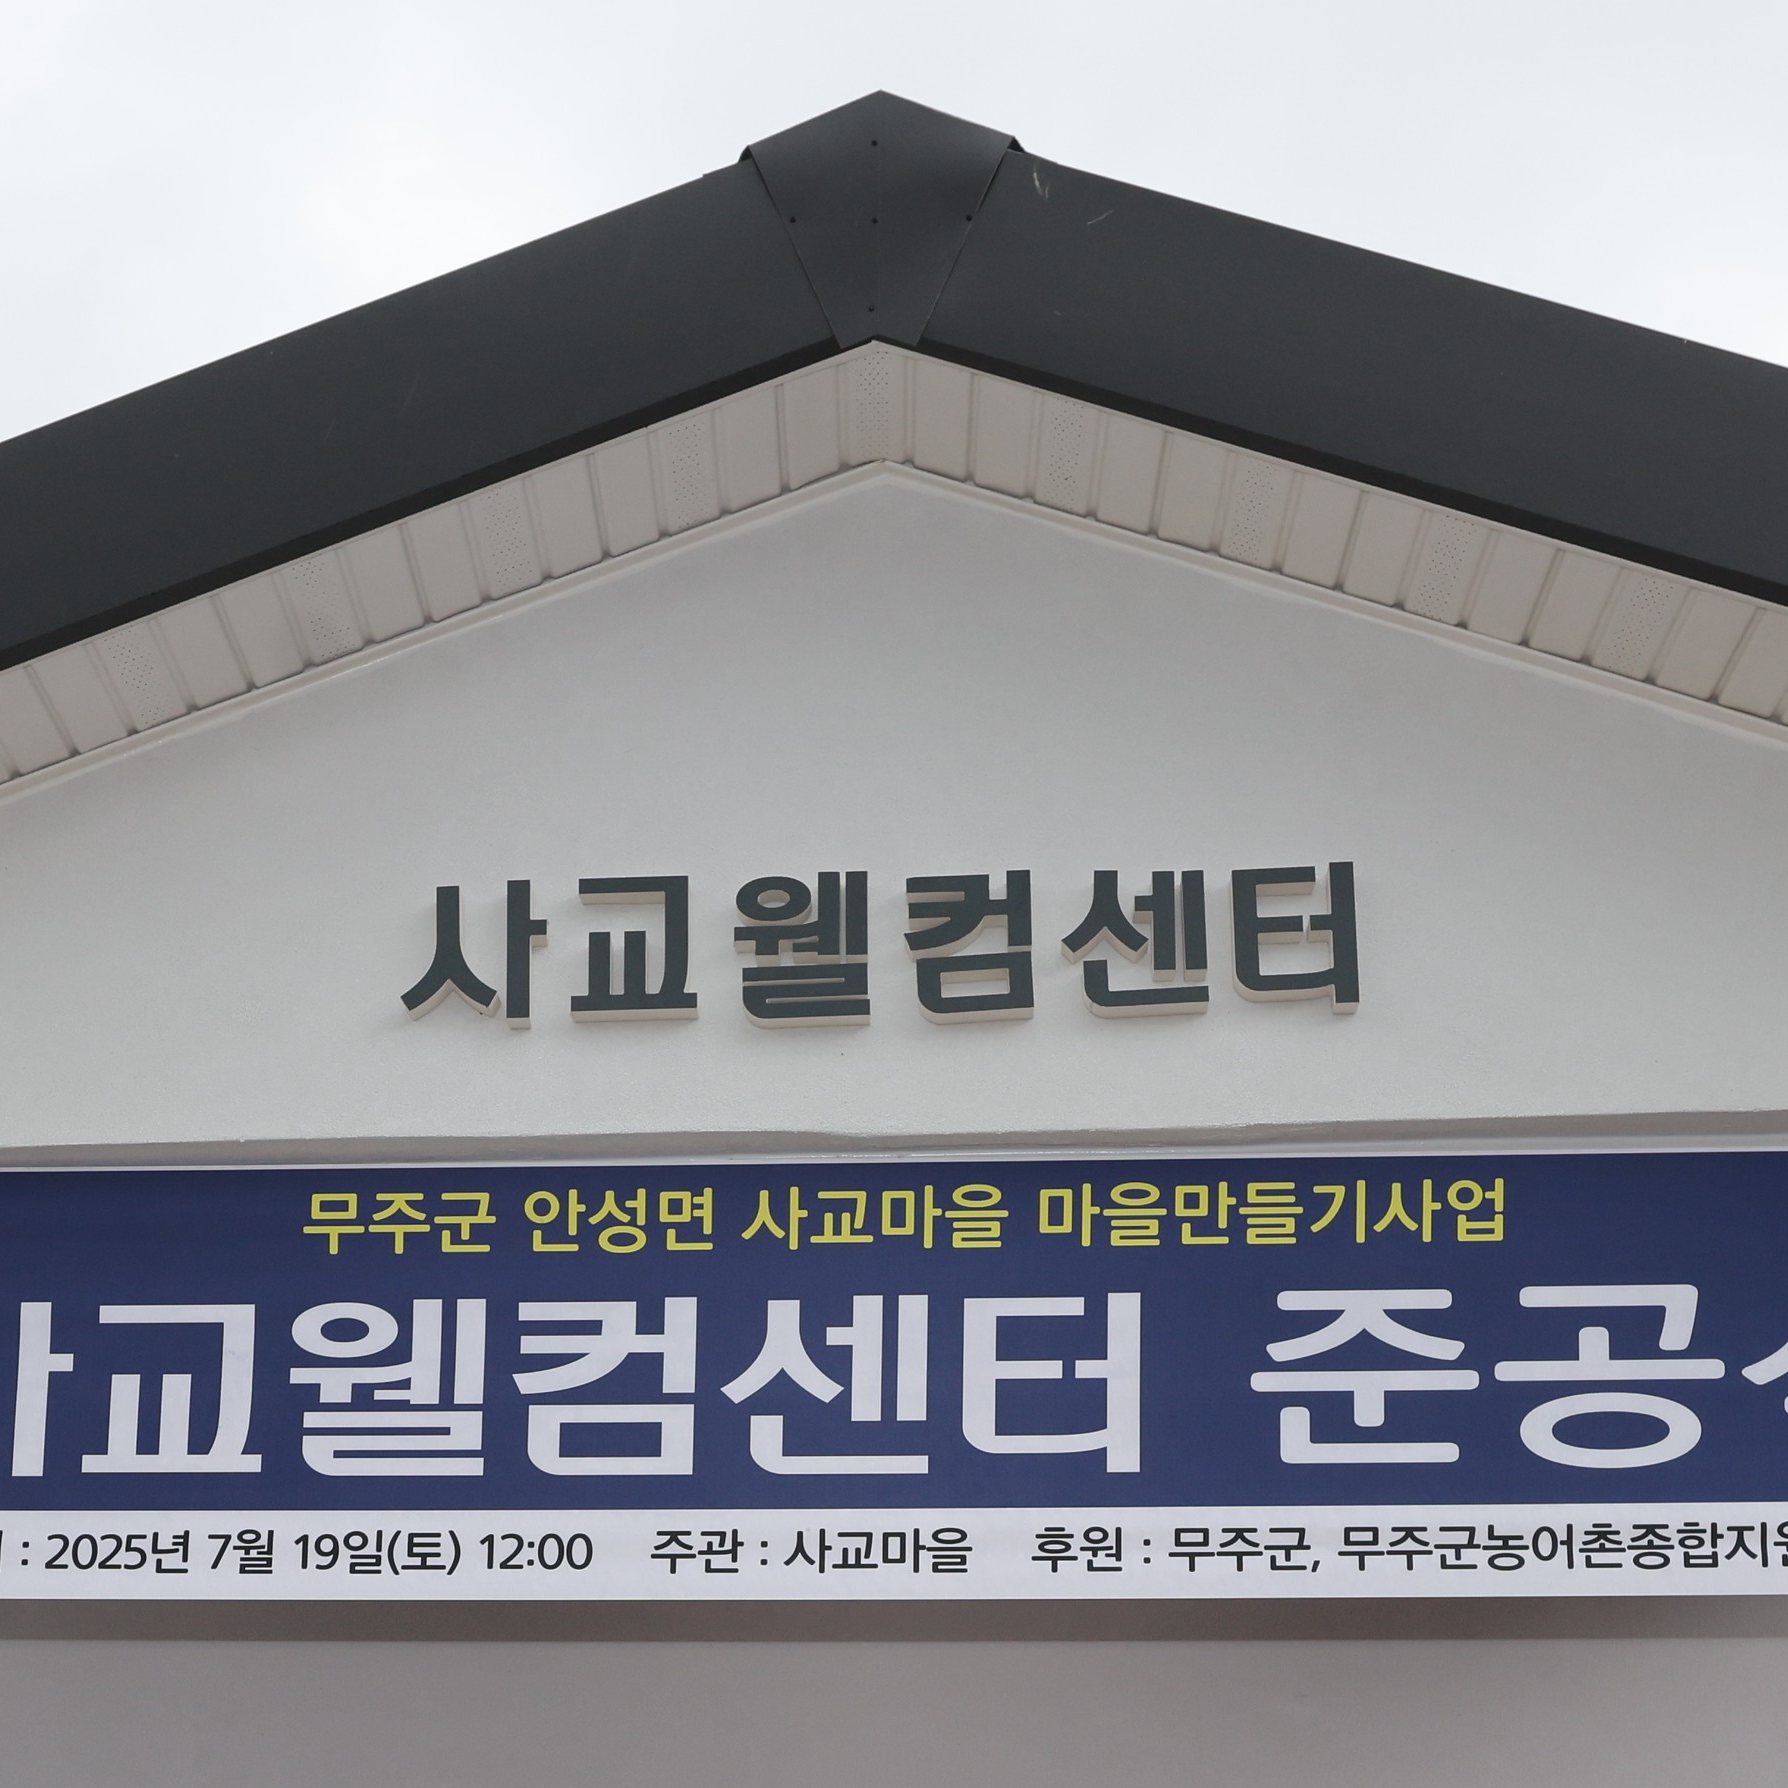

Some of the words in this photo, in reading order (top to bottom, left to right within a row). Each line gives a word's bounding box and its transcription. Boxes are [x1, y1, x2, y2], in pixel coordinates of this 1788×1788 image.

[399, 861, 1361, 1029] 사교웰컴센터
[304, 1192, 497, 1255] 무주군
[524, 1187, 714, 1253] 안성면
[742, 1184, 1009, 1250] 사교마을
[1039, 1178, 1505, 1247] 마을만들기사업
[44, 1529, 190, 1574] 2025년
[207, 1528, 275, 1575] 7월
[294, 1529, 461, 1576] 19일(토)
[479, 1533, 593, 1571] 12:00
[650, 1528, 745, 1575] 주관
[783, 1527, 973, 1574] 사교마을
[1031, 1526, 1123, 1573] 후원
[1168, 1527, 1321, 1575] 무주군,
